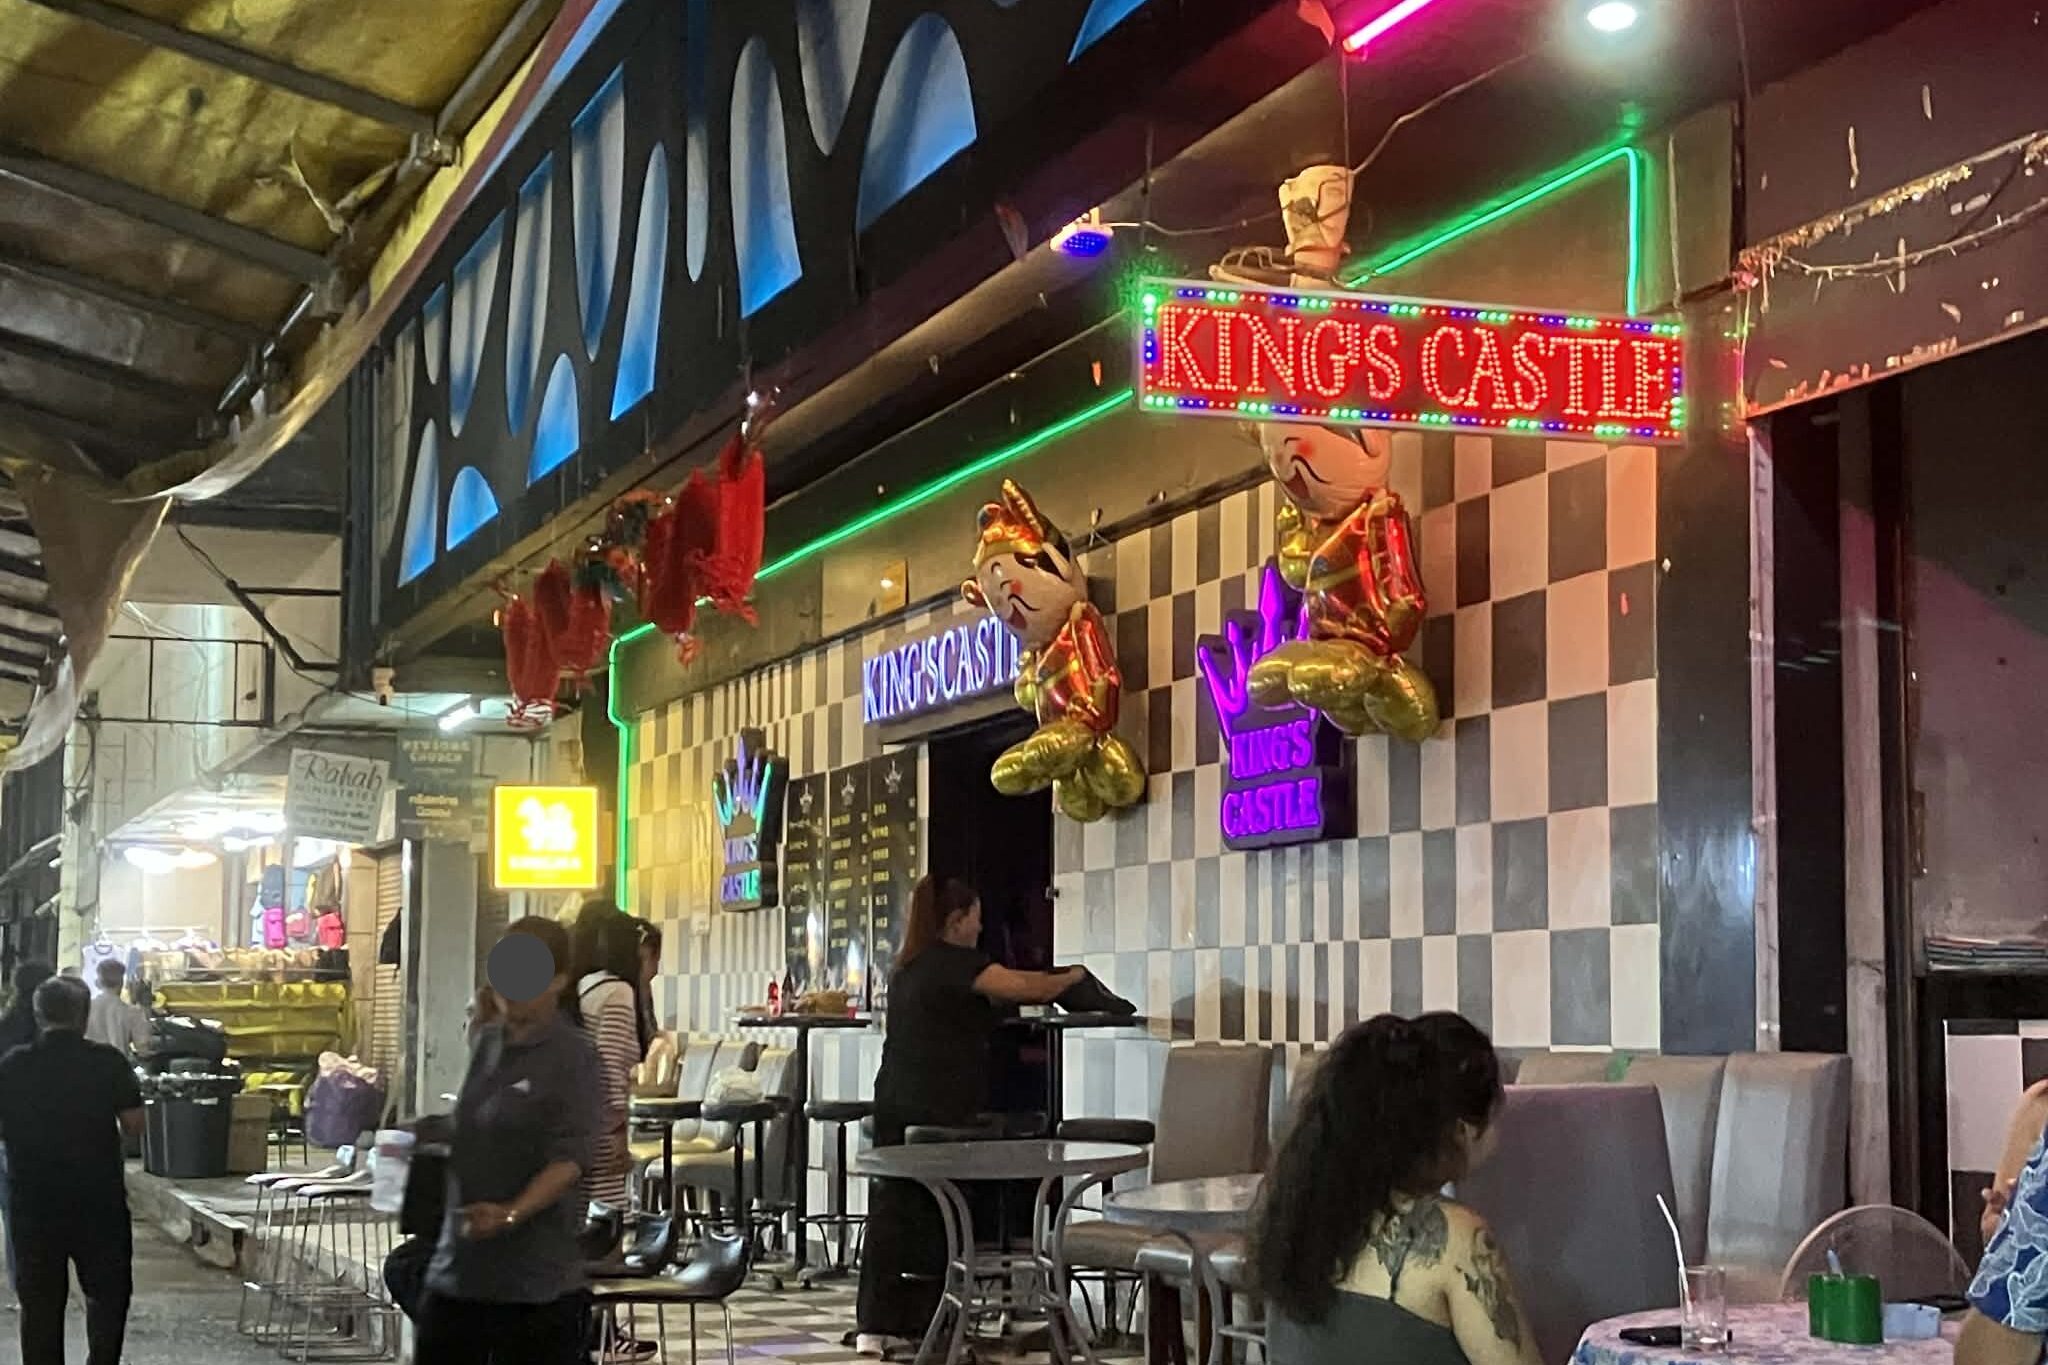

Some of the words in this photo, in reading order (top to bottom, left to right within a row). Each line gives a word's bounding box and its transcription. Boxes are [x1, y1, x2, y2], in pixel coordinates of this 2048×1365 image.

[1155, 305, 1402, 401] KING'S
[1420, 325, 1671, 420] CASTLE
[296, 754, 382, 792] Rahab
[1230, 719, 1312, 779] KING'S
[1223, 777, 1321, 838] CASTLE
[720, 867, 761, 904] CASTLE
